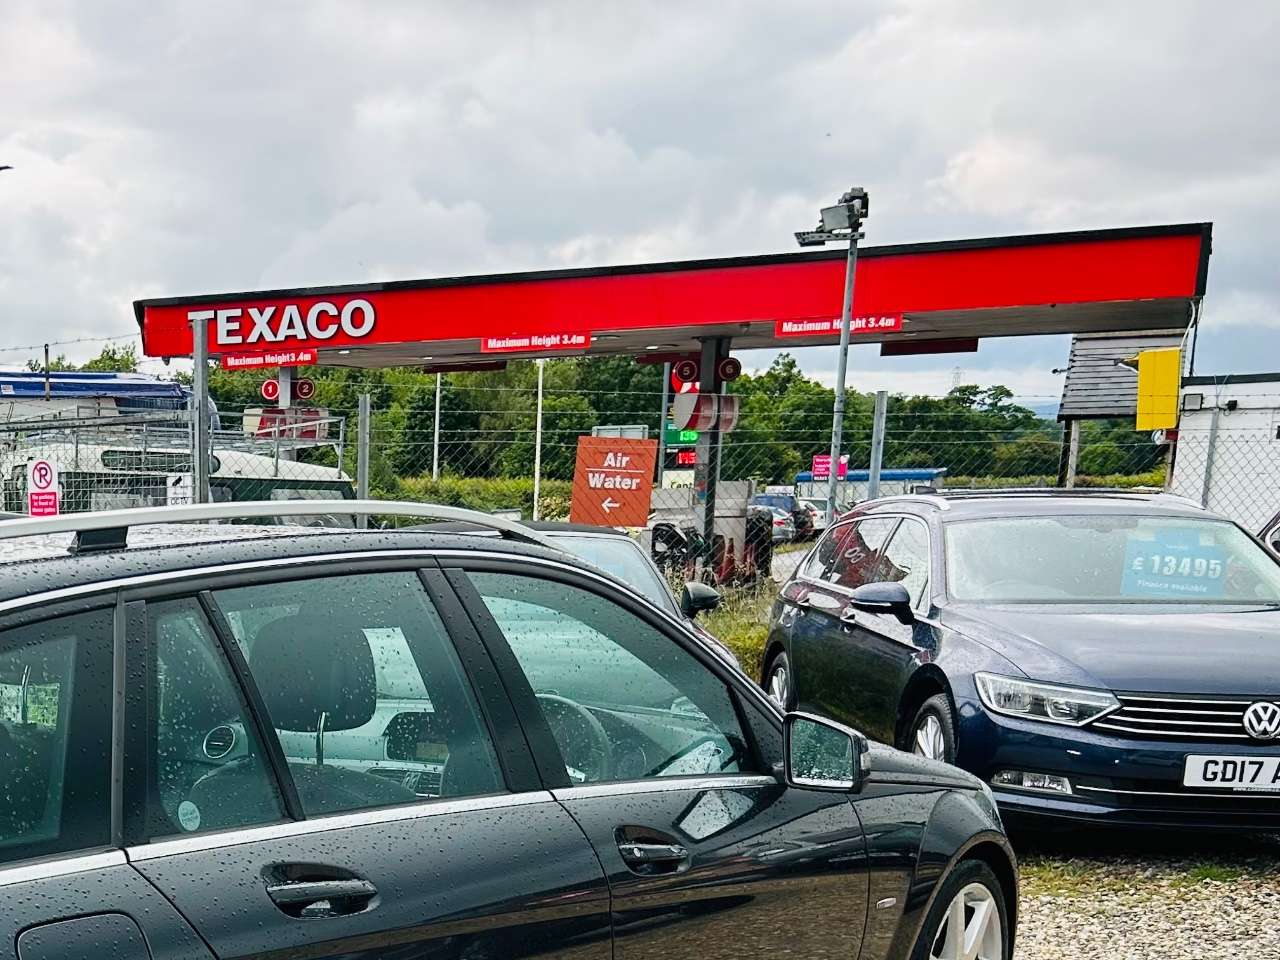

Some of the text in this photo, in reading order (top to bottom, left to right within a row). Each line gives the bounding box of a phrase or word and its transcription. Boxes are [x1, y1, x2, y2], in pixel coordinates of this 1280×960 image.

[782, 317, 895, 333] Maximum Hght 3.4m
[487, 334, 586, 349] Maximum Height 3.4m
[227, 355, 264, 367] Maximum
[603, 452, 630, 468] Air
[588, 472, 641, 490] Water
[1151, 554, 1222, 579] 13495
[1202, 760, 1264, 783] GD17
